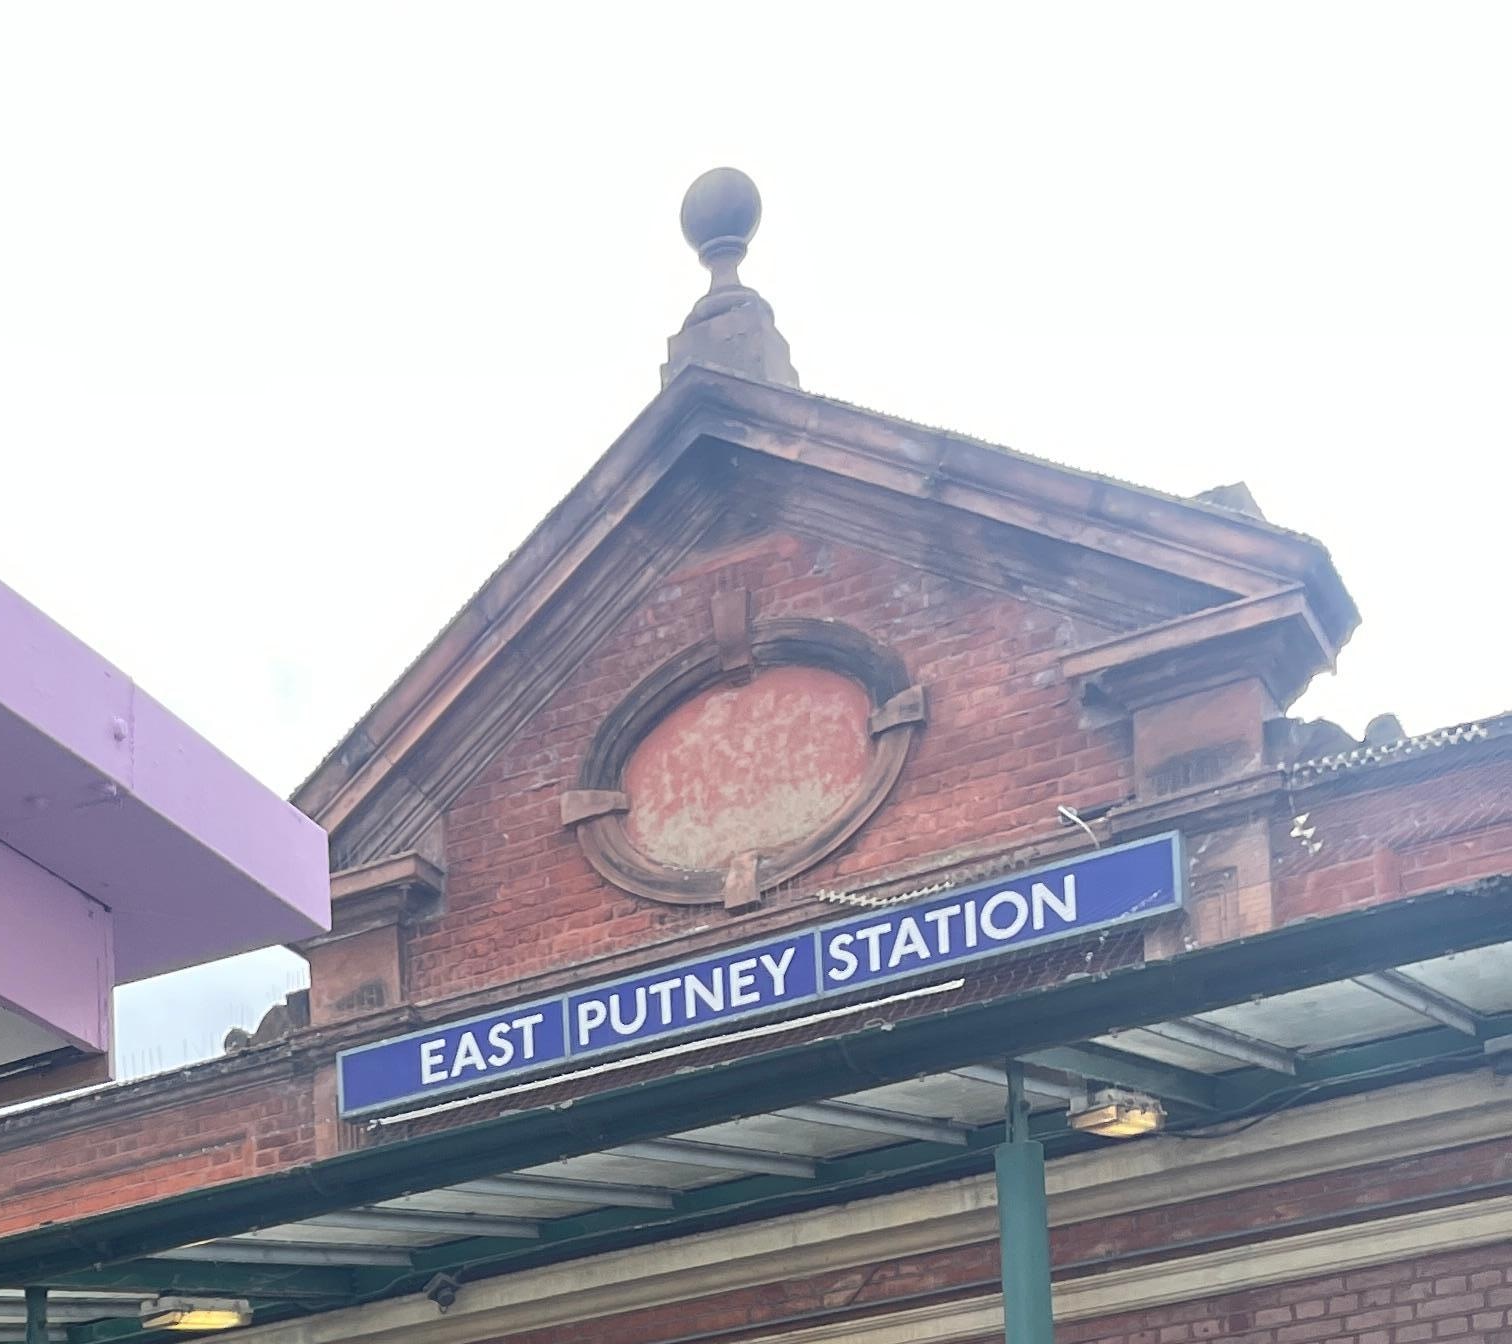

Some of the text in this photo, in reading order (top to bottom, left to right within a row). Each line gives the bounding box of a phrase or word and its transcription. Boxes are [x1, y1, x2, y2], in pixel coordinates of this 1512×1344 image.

[420, 874, 1077, 1085] EAST PUTNEY STATION
